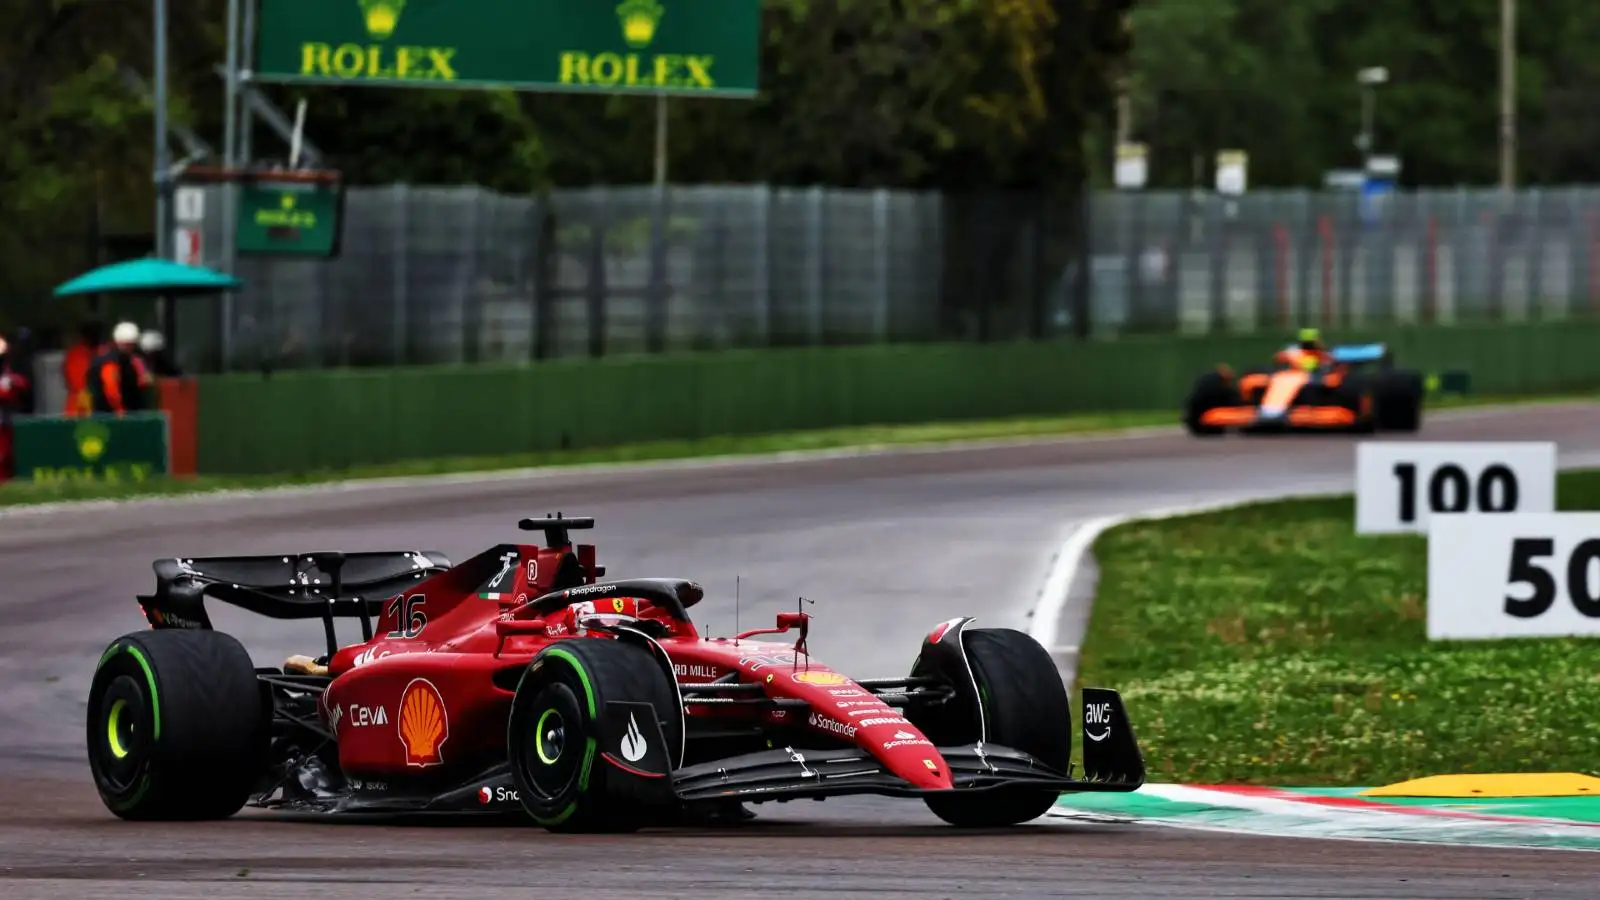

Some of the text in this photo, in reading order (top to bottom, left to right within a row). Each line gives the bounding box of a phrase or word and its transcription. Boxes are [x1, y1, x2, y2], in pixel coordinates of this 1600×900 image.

[301, 41, 457, 80] ROLEX
[560, 51, 716, 90] ROLEX
[1394, 462, 1519, 523] 100
[571, 584, 616, 596] Snapdragon
[1504, 538, 1600, 619] 50
[385, 593, 428, 639] 16
[689, 665, 717, 678] MILLE
[817, 713, 858, 739] Santander
[1086, 702, 1110, 724] aws
